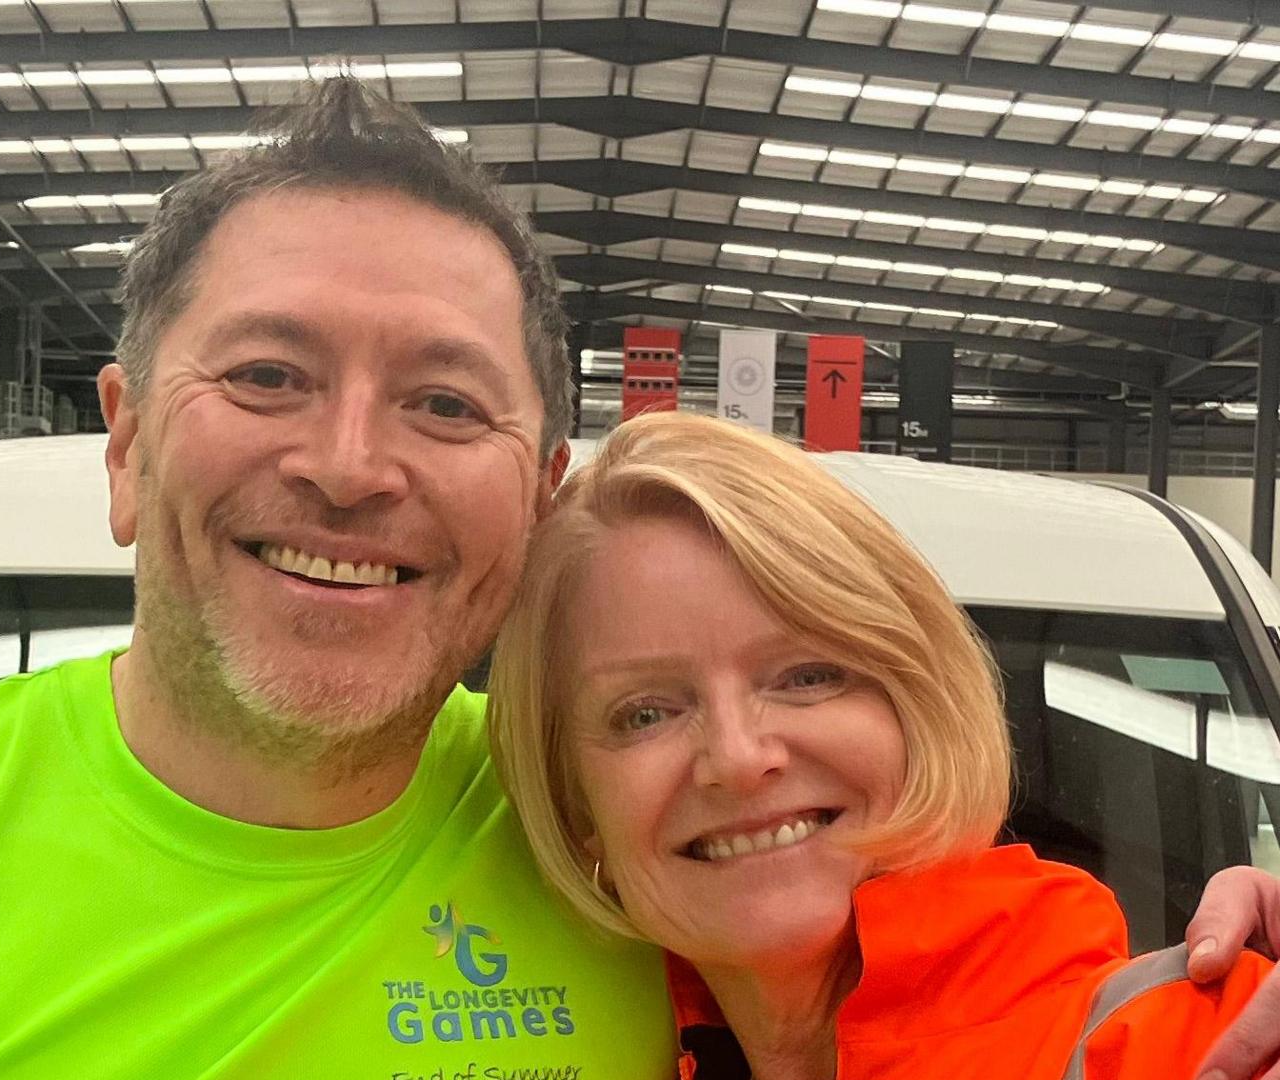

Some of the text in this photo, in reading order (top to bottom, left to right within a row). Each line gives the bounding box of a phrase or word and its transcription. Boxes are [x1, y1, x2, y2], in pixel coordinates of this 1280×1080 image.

[382, 981, 567, 1010] THE LONGEVITY
[387, 1002, 575, 1044] Games
